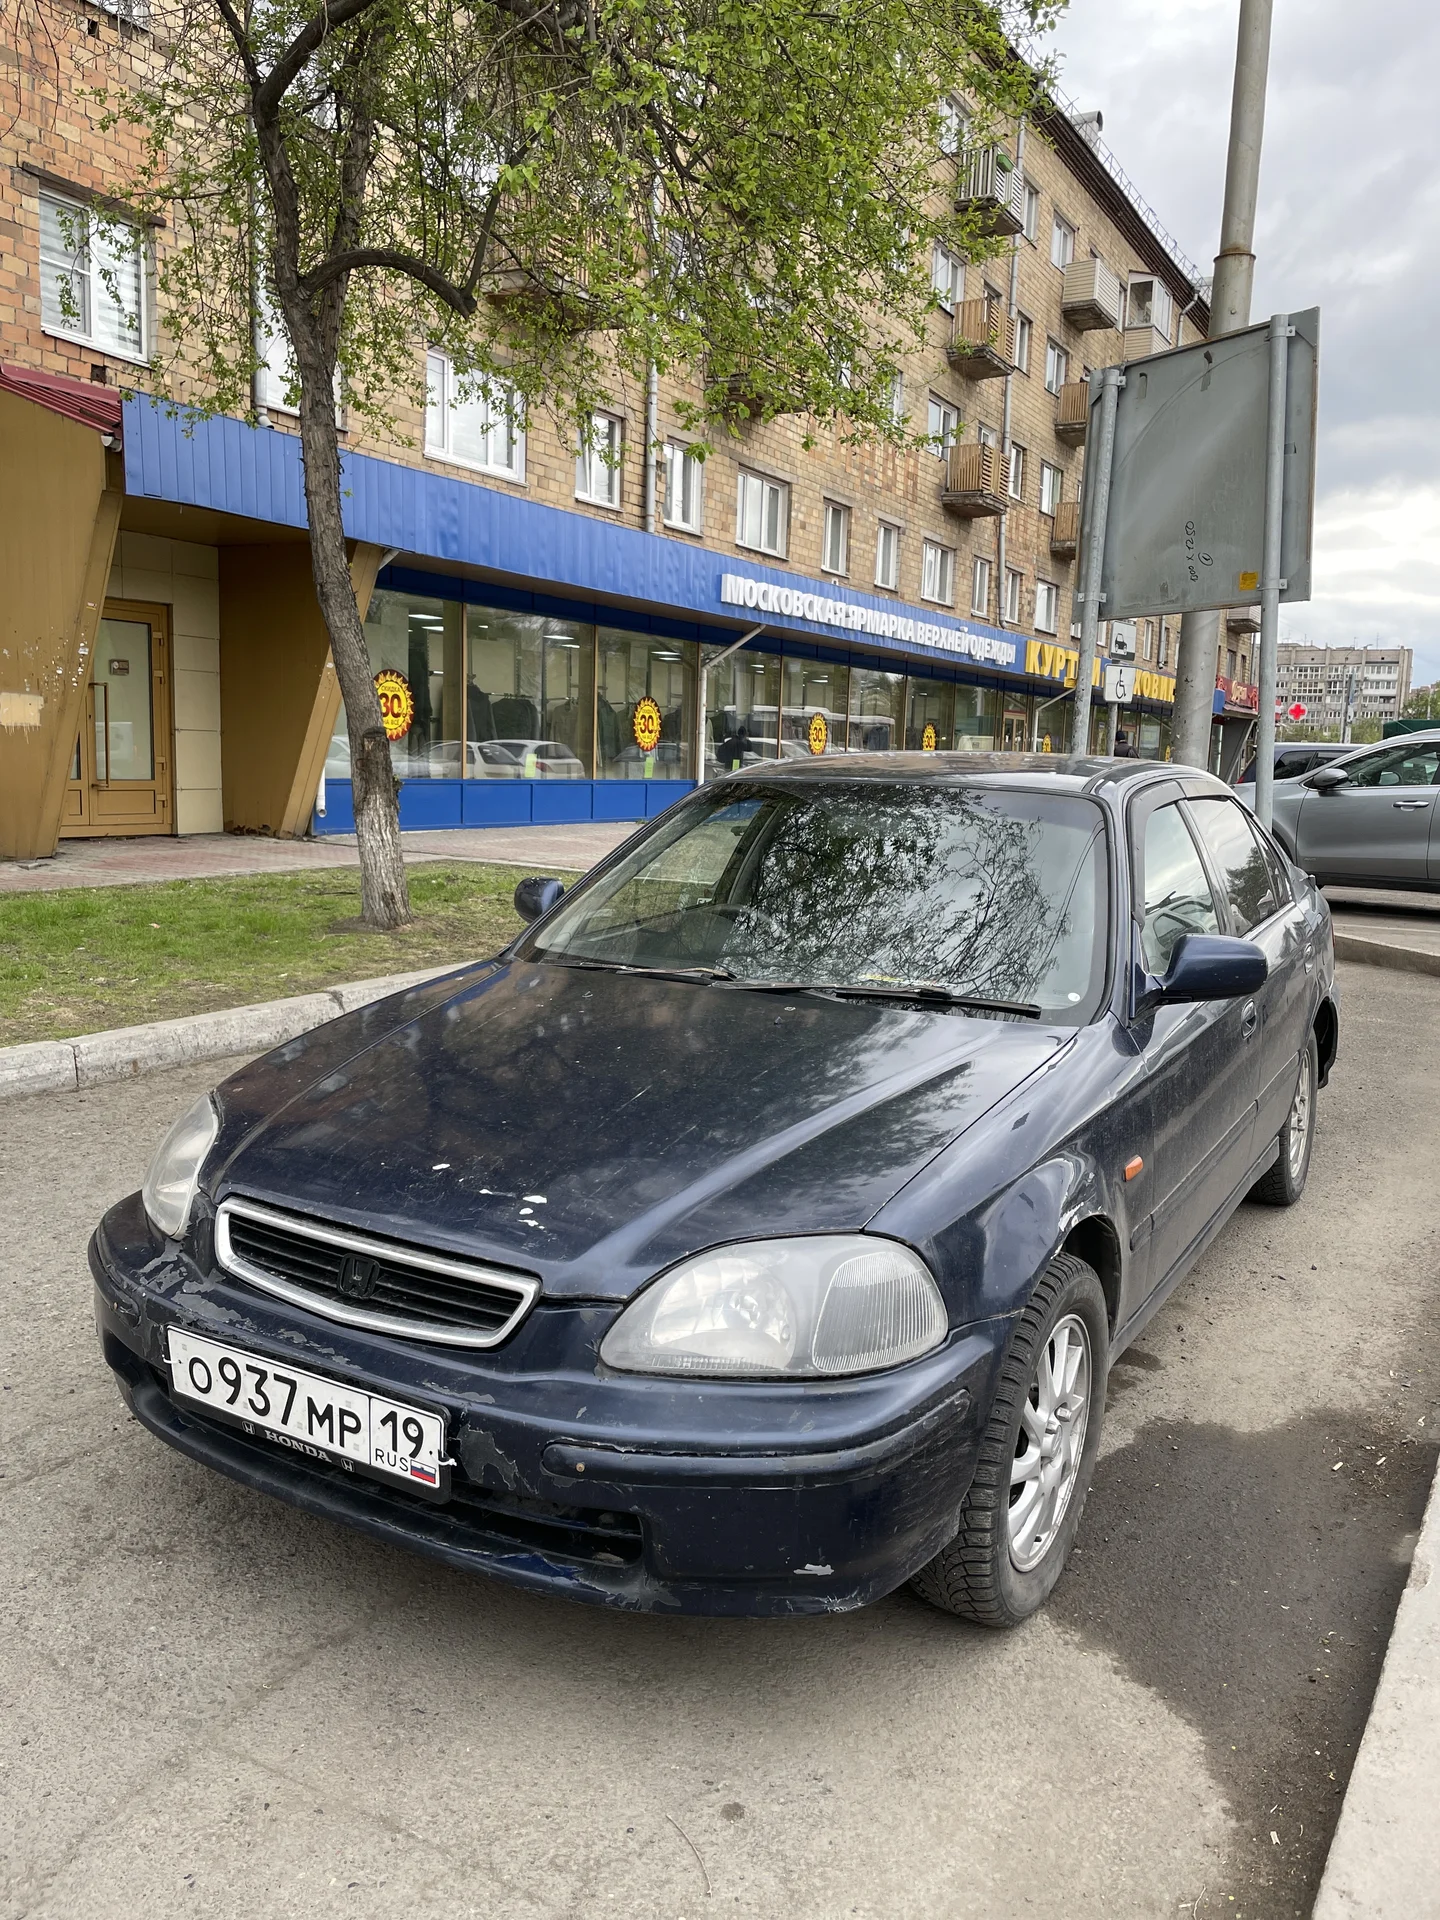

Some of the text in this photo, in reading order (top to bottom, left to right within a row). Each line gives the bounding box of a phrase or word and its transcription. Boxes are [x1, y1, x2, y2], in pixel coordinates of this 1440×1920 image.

[721, 573, 1016, 666] МОСКОВСКАЯ ЯРМАРКА ВЕРХНЕЙ ОДЕЖДЫ
[1025, 640, 1177, 704] КУРТИ ХОВИК
[264, 1429, 333, 1463] HONDA
[380, 1410, 425, 1458] 19
[375, 1448, 409, 1473] RUS
